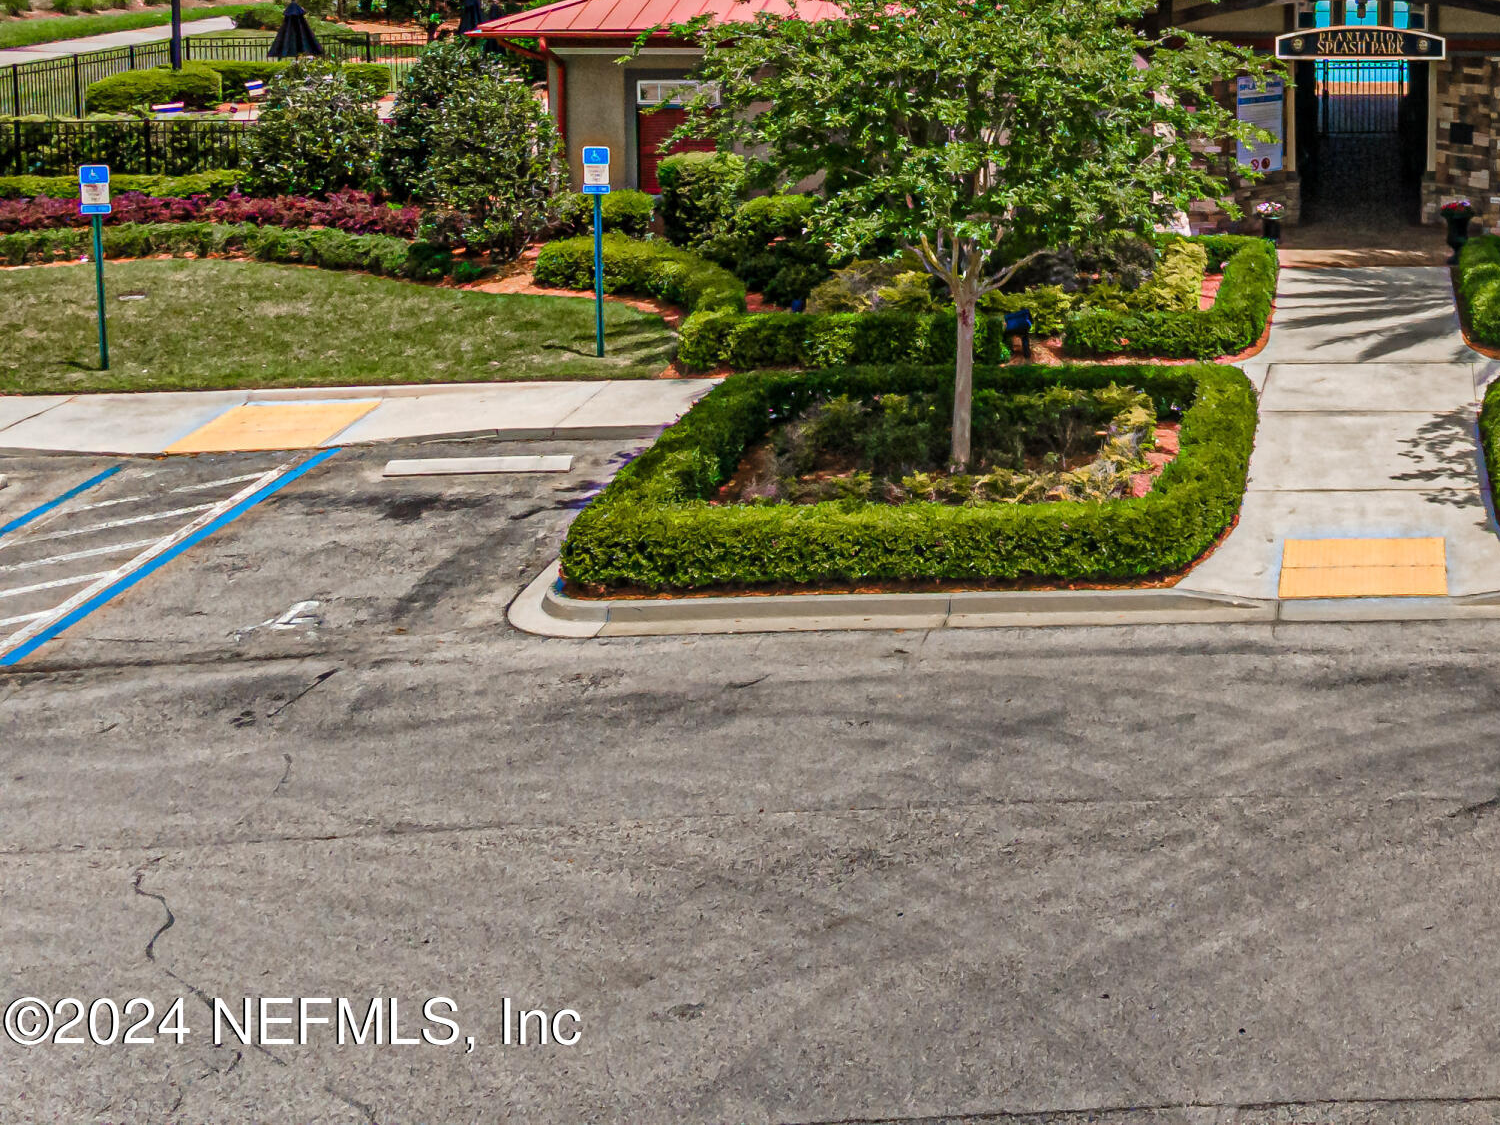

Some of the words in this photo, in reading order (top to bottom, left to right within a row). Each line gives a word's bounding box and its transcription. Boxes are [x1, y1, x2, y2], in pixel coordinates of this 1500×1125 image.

[1319, 31, 1404, 42] PLANTATION
[1317, 41, 1366, 54] SPLASH
[1371, 41, 1404, 54] PARK
